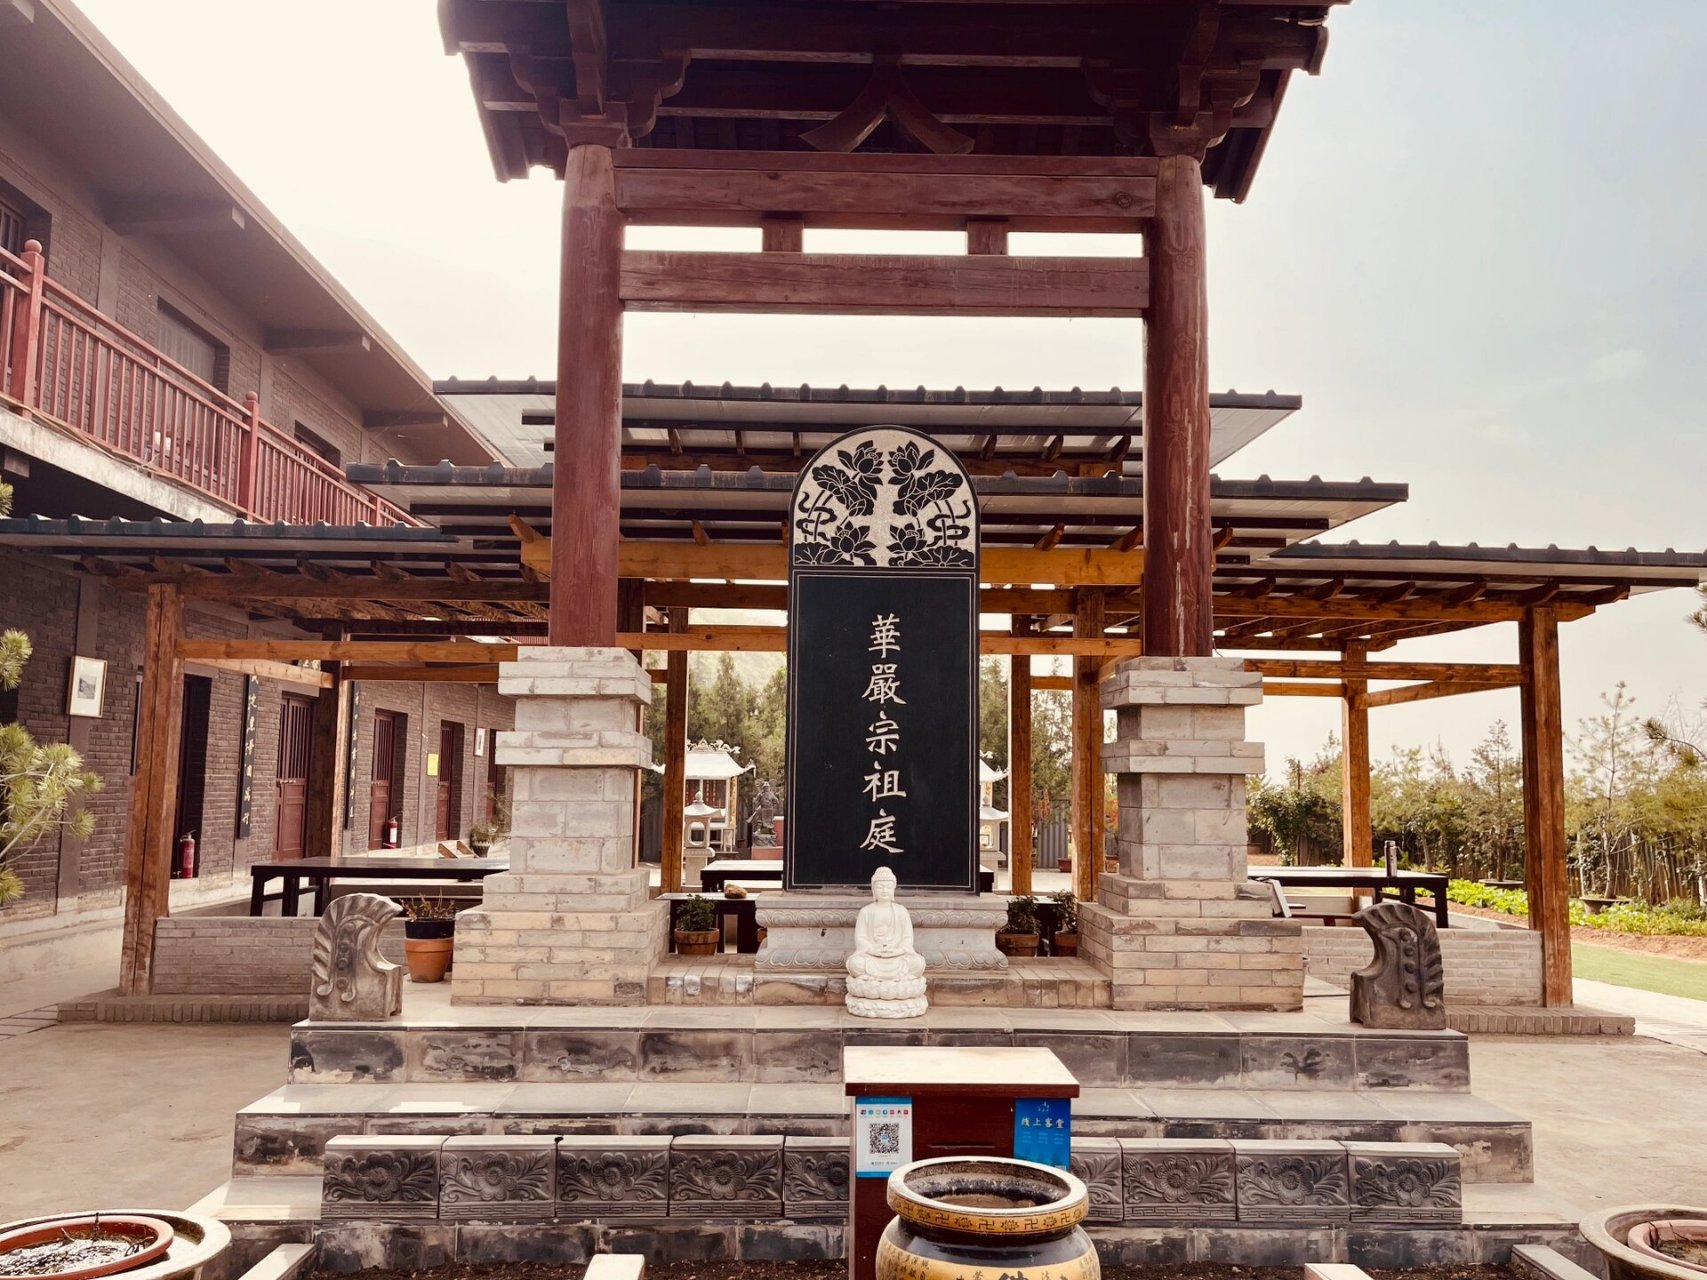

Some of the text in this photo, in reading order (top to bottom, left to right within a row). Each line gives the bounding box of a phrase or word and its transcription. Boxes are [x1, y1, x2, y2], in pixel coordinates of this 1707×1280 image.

[860, 613, 907, 853] 華嚴宗祖庭
